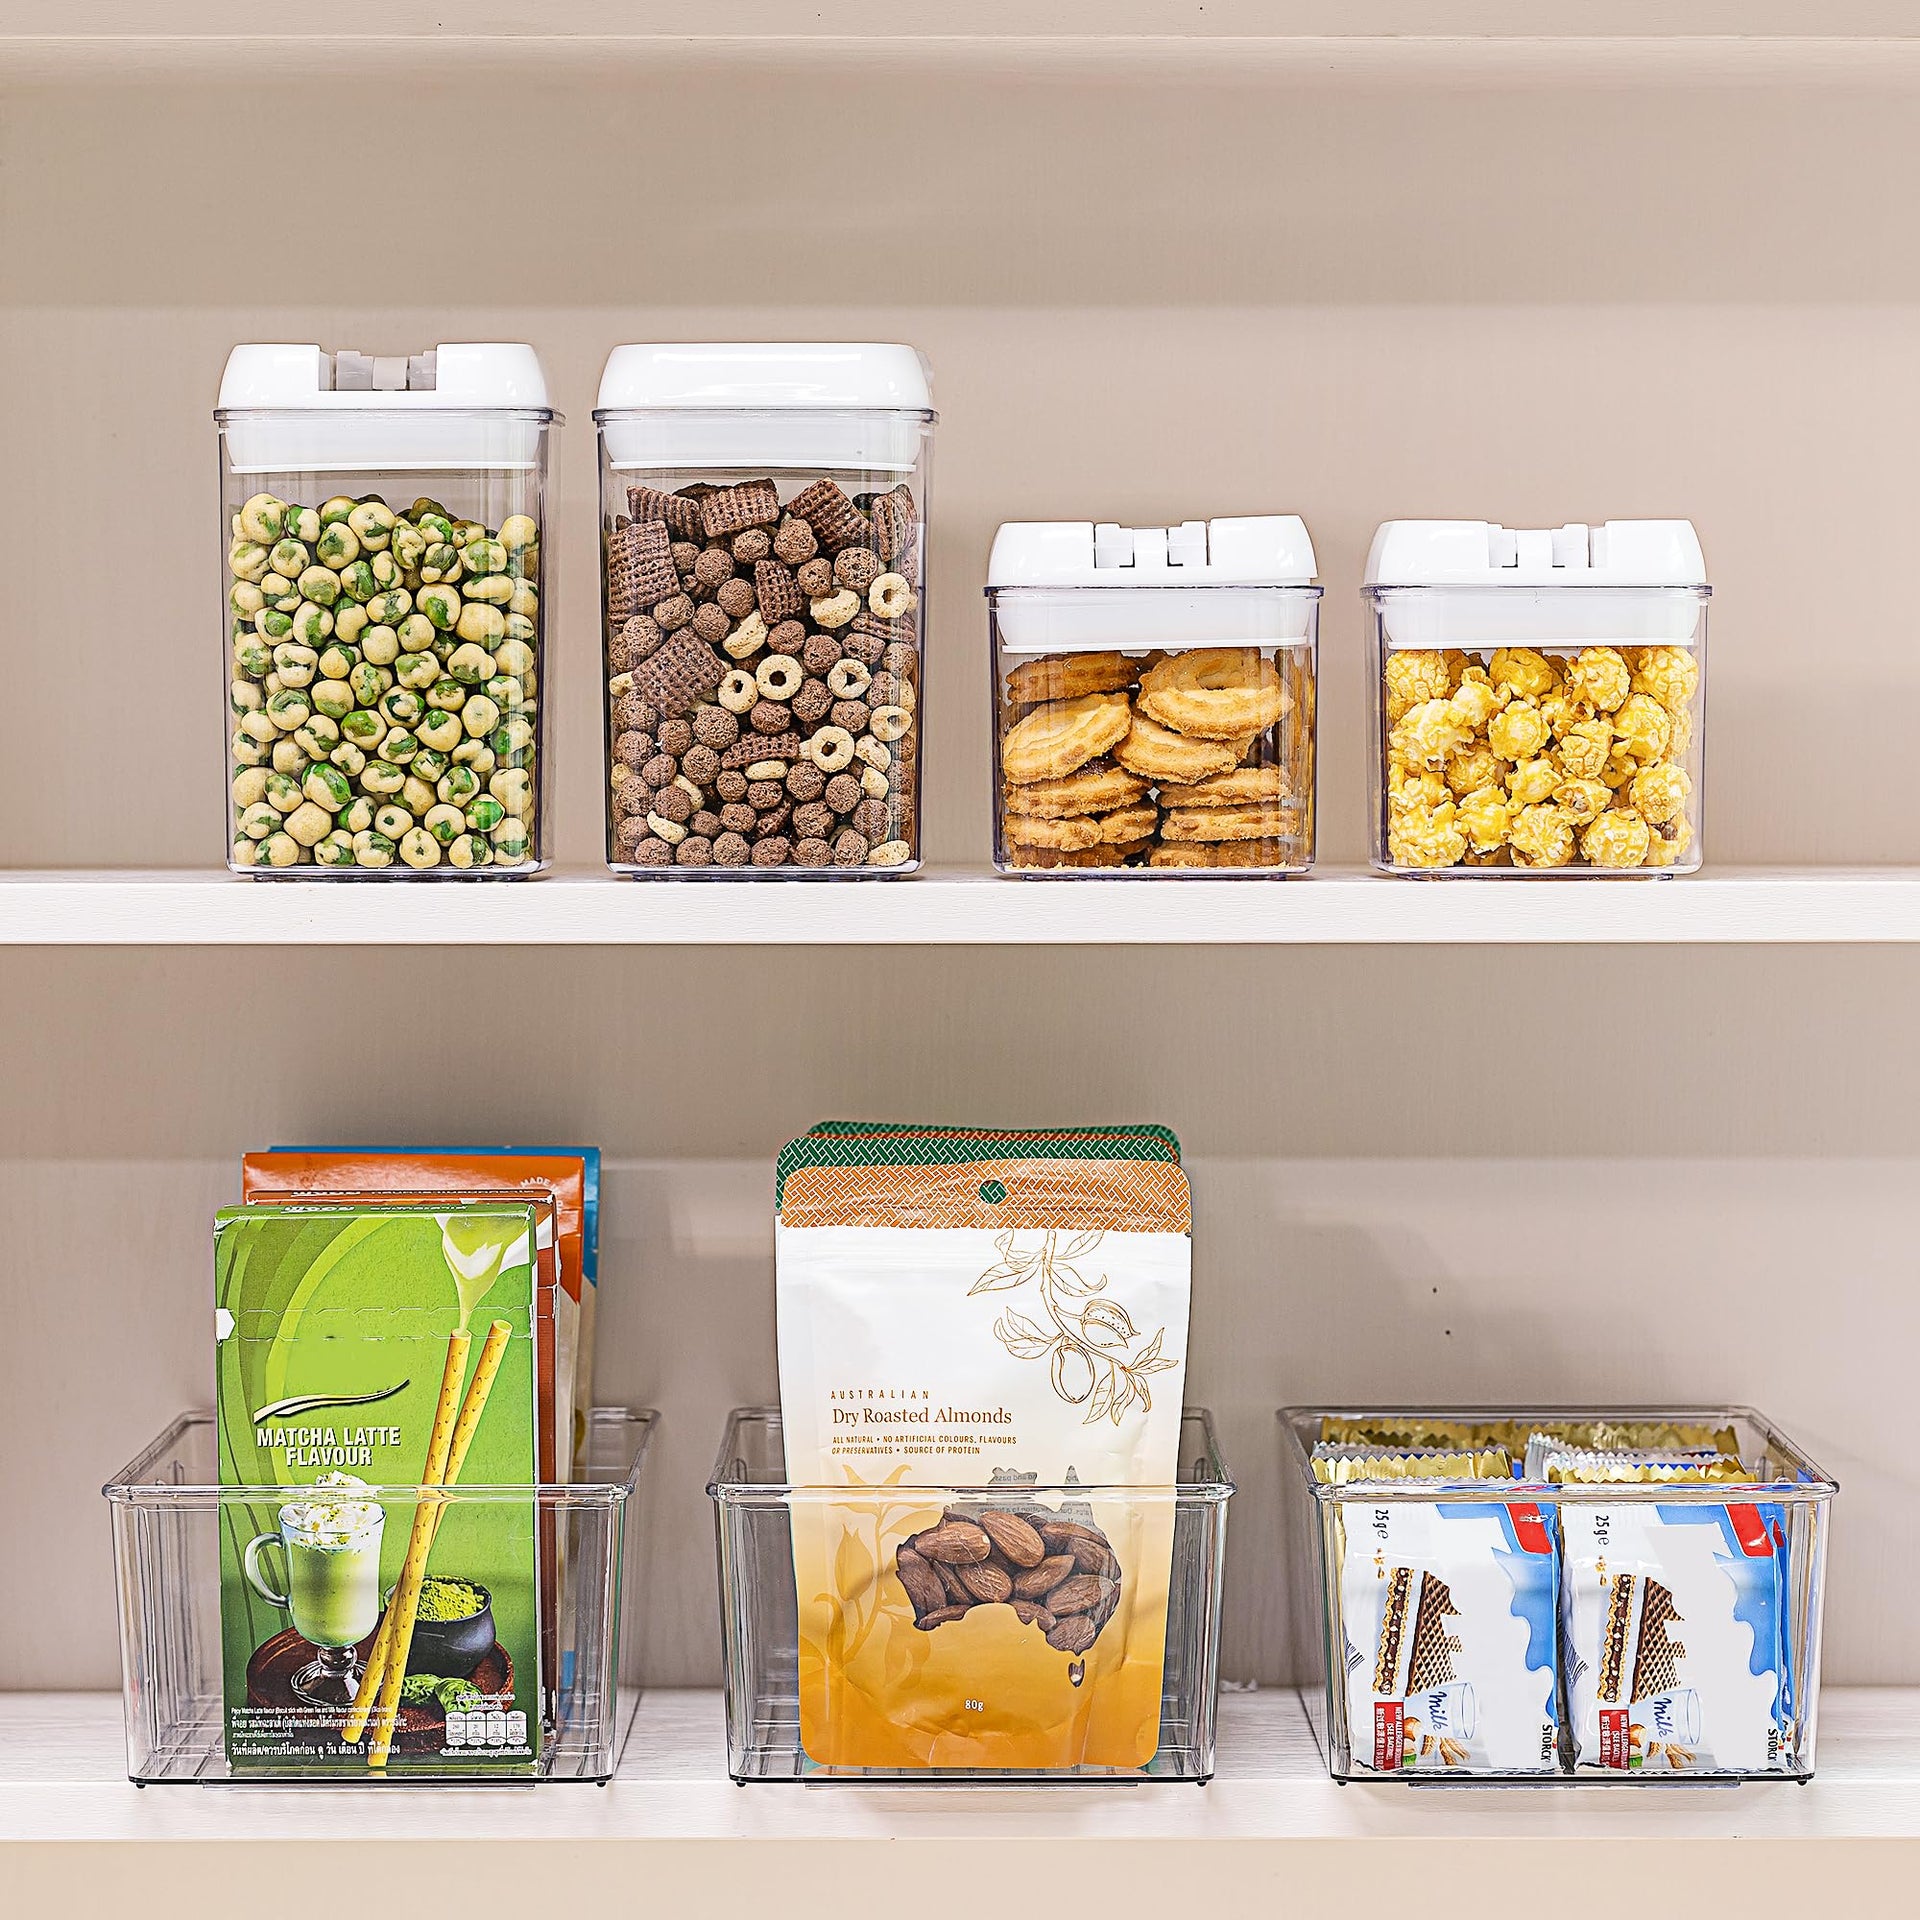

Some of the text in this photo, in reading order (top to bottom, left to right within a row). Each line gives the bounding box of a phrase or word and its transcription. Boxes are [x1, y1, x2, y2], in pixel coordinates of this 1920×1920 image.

[520, 1176, 551, 1188] MADE
[831, 1389, 929, 1400] AUSTRALIAN
[833, 1407, 1012, 1427] Dry Roasted Almonds
[256, 1427, 401, 1447] MATCHA LATTE
[833, 1436, 844, 1444] ALL
[846, 1436, 873, 1444] NATURAL
[883, 1435, 893, 1443] NO
[895, 1435, 936, 1443] ARTIFICIAL
[979, 1435, 1017, 1445] FLAVOURS
[286, 1447, 373, 1467] FLAVOUR
[842, 1446, 893, 1455] PRESERVATIVES
[904, 1446, 933, 1454] SOURCE
[936, 1446, 945, 1454] OF
[948, 1446, 980, 1454] PROTEIN
[965, 1699, 984, 1712] 80g
[1540, 1724, 1553, 1761] STORCK
[1767, 1728, 1778, 1761] STORCK
